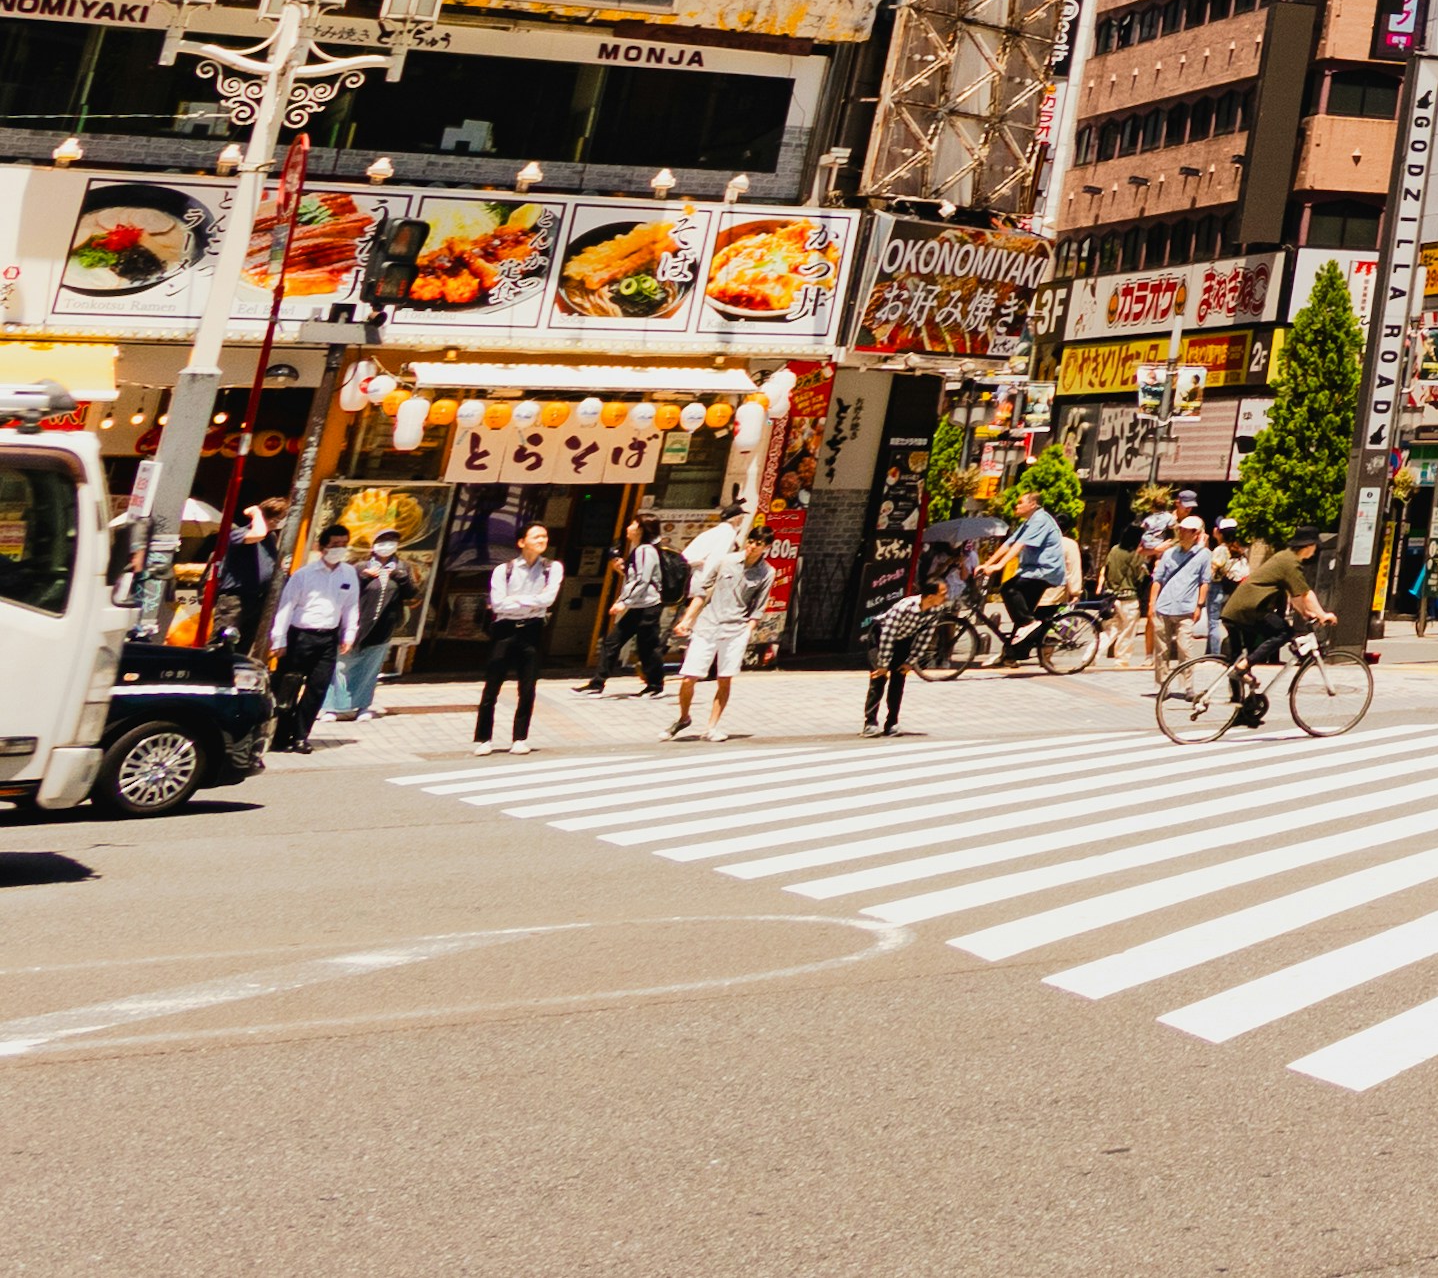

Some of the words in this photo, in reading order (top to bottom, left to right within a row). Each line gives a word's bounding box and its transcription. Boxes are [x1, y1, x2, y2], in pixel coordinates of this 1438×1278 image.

[597, 43, 705, 69] MONJA
[1389, 115, 1434, 302] GODZILLA
[163, 207, 204, 298] ラーメン
[517, 207, 555, 290] とんかつ
[656, 216, 699, 284] そば
[785, 222, 839, 323] かつ丼
[879, 237, 1051, 290] OKONOMIYAKI
[63, 296, 125, 314] Tonkotsu
[127, 298, 178, 314] Ramen
[874, 282, 1022, 337] お好み焼き
[1036, 288, 1068, 337] 3F
[1115, 277, 1178, 326] カラオケ
[1196, 262, 1270, 327] まねきねこ
[1251, 342, 1268, 373] 2F
[1372, 323, 1402, 415] ROAD
[462, 431, 663, 476] とらそば
